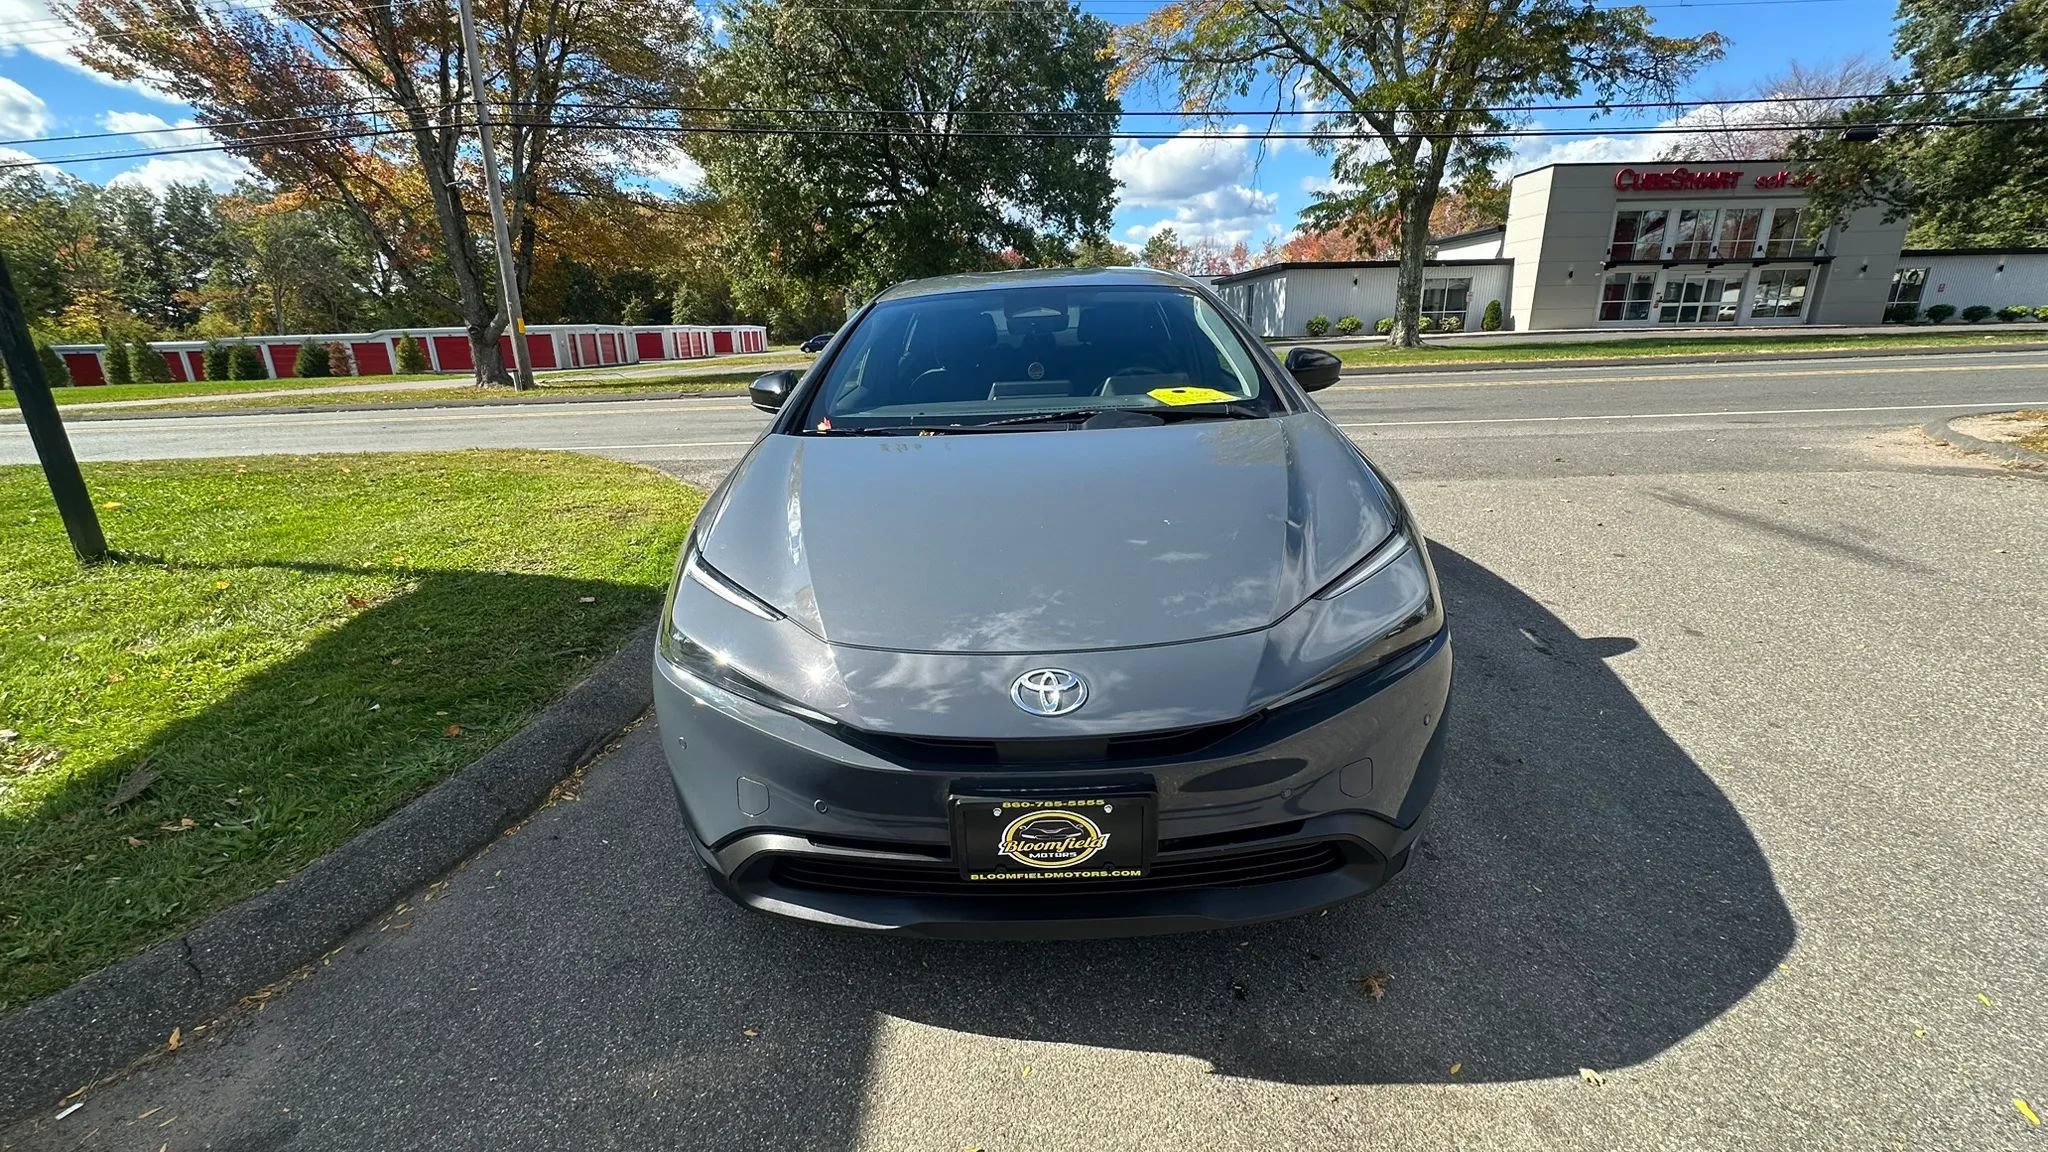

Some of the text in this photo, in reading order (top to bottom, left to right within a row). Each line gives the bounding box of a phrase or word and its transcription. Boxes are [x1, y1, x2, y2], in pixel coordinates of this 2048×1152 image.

[1755, 171, 1789, 189] self
[1002, 799, 1105, 809] 860-785-5555
[1003, 836, 1106, 853] Bloomfield
[970, 870, 1142, 880] BLOOMFIELDMOTORS.COM
